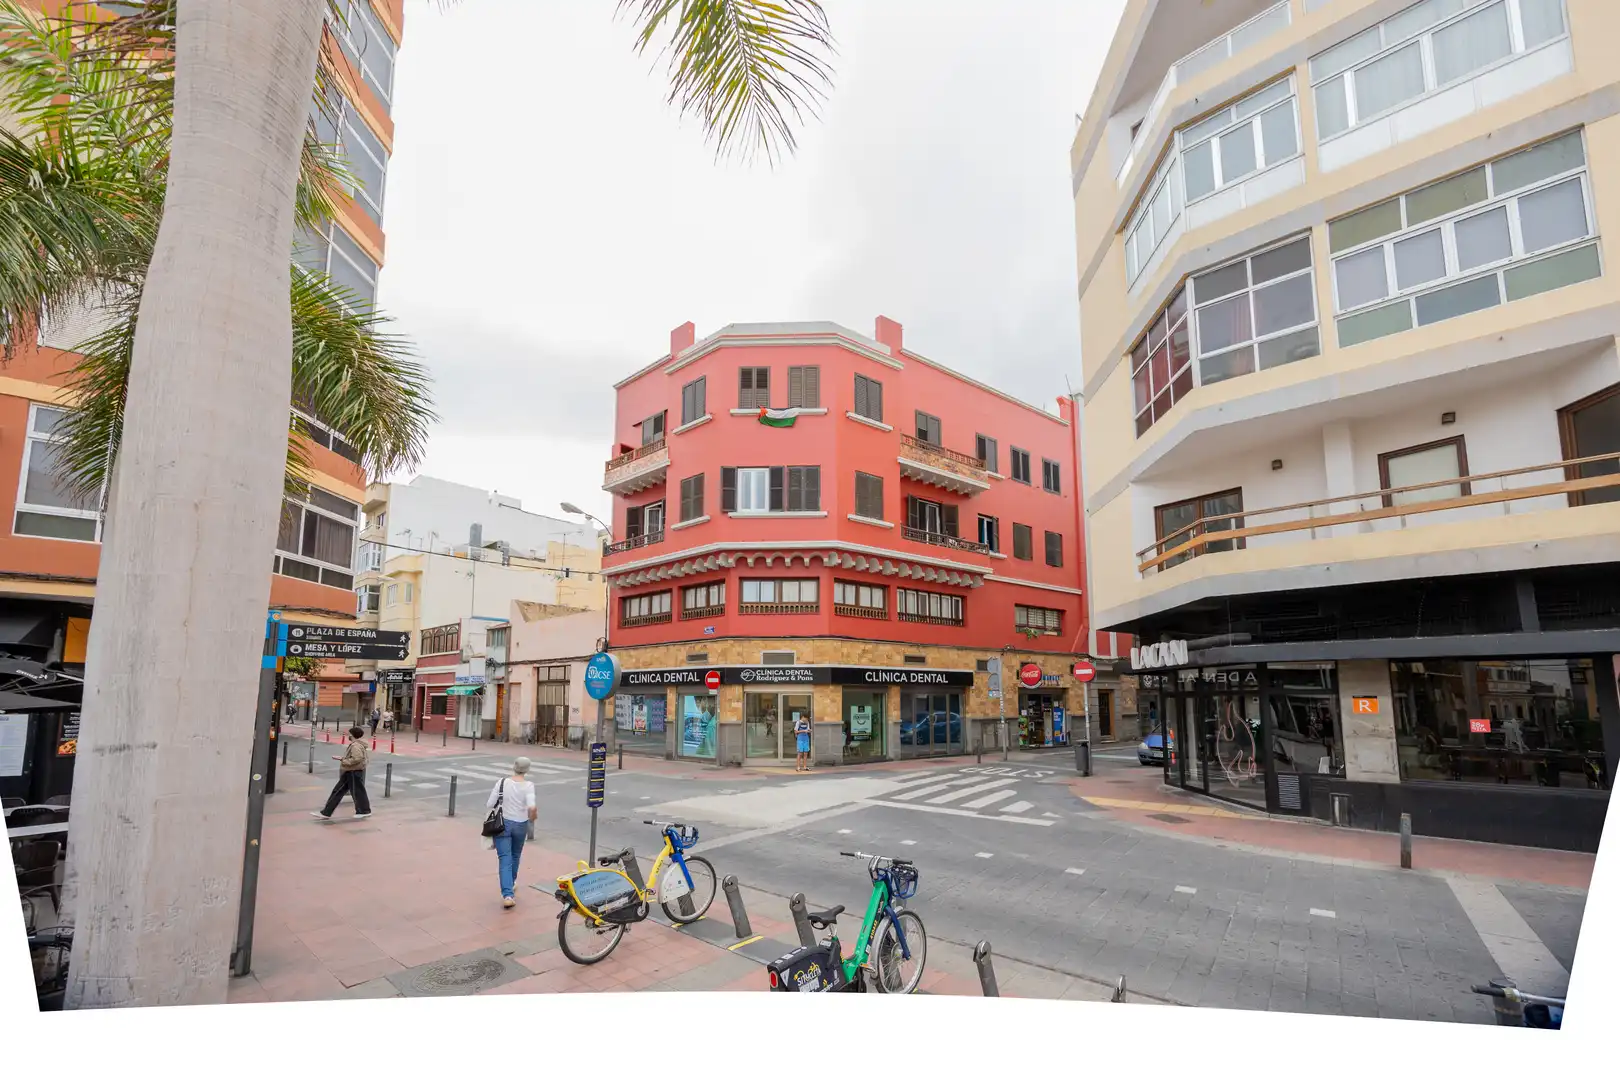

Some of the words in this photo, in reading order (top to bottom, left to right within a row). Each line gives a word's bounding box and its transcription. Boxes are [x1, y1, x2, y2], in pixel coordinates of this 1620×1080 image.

[306, 627, 333, 636] PLAZA
[335, 629, 345, 637] DE
[347, 628, 377, 639] ESPAÑA
[305, 643, 328, 652] MESA
[337, 643, 362, 653] LÓPEZ
[629, 672, 662, 684] CLÍNICA
[663, 671, 700, 683] DENTAL
[865, 670, 908, 682] CLÍNICA
[910, 672, 949, 684] DENTAL
[1359, 699, 1373, 713] R
[958, 766, 1055, 778] STOP
